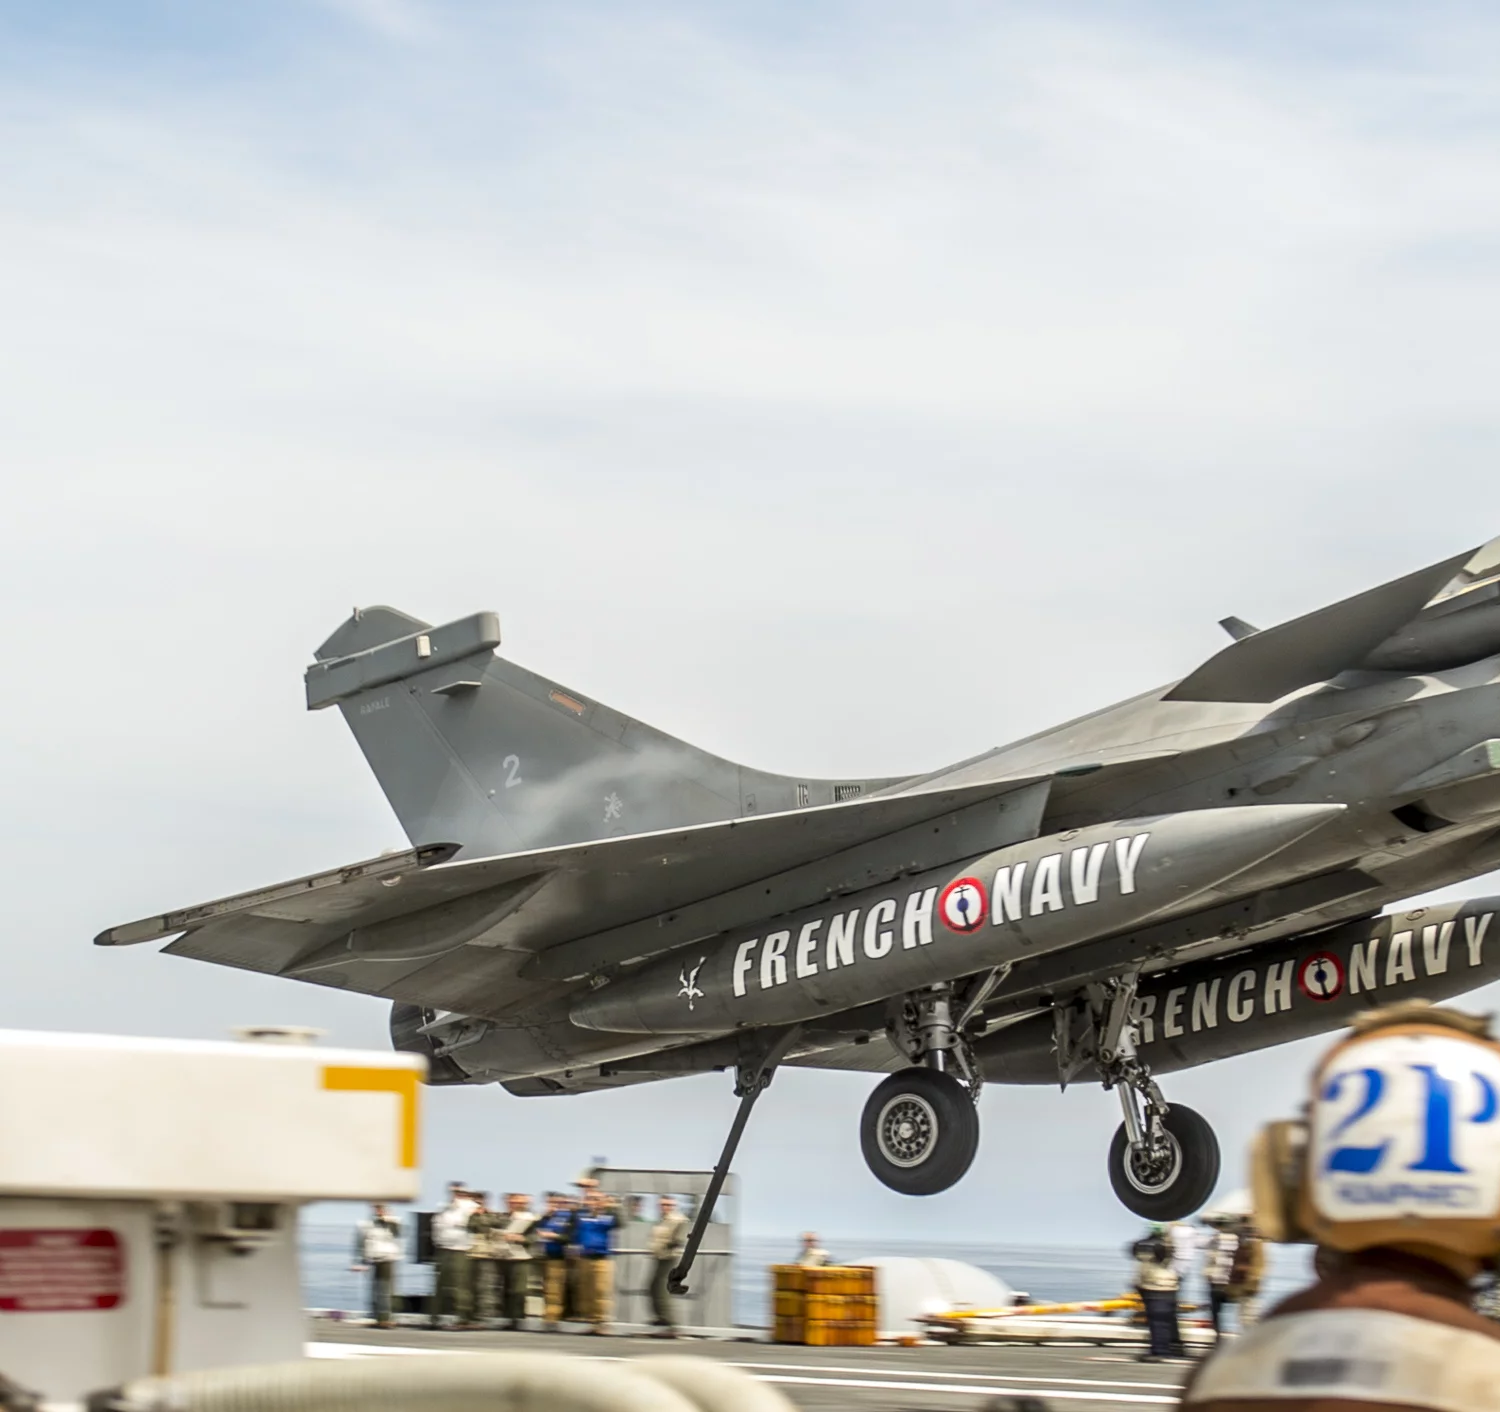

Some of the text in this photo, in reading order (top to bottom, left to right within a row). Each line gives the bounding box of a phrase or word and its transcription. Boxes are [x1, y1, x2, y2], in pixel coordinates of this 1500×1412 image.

[502, 754, 522, 788] 2
[732, 832, 1151, 998] FRENCH NAVY
[1131, 912, 1495, 1046] RENCH NAVY
[1319, 1064, 1500, 1175] 2P
